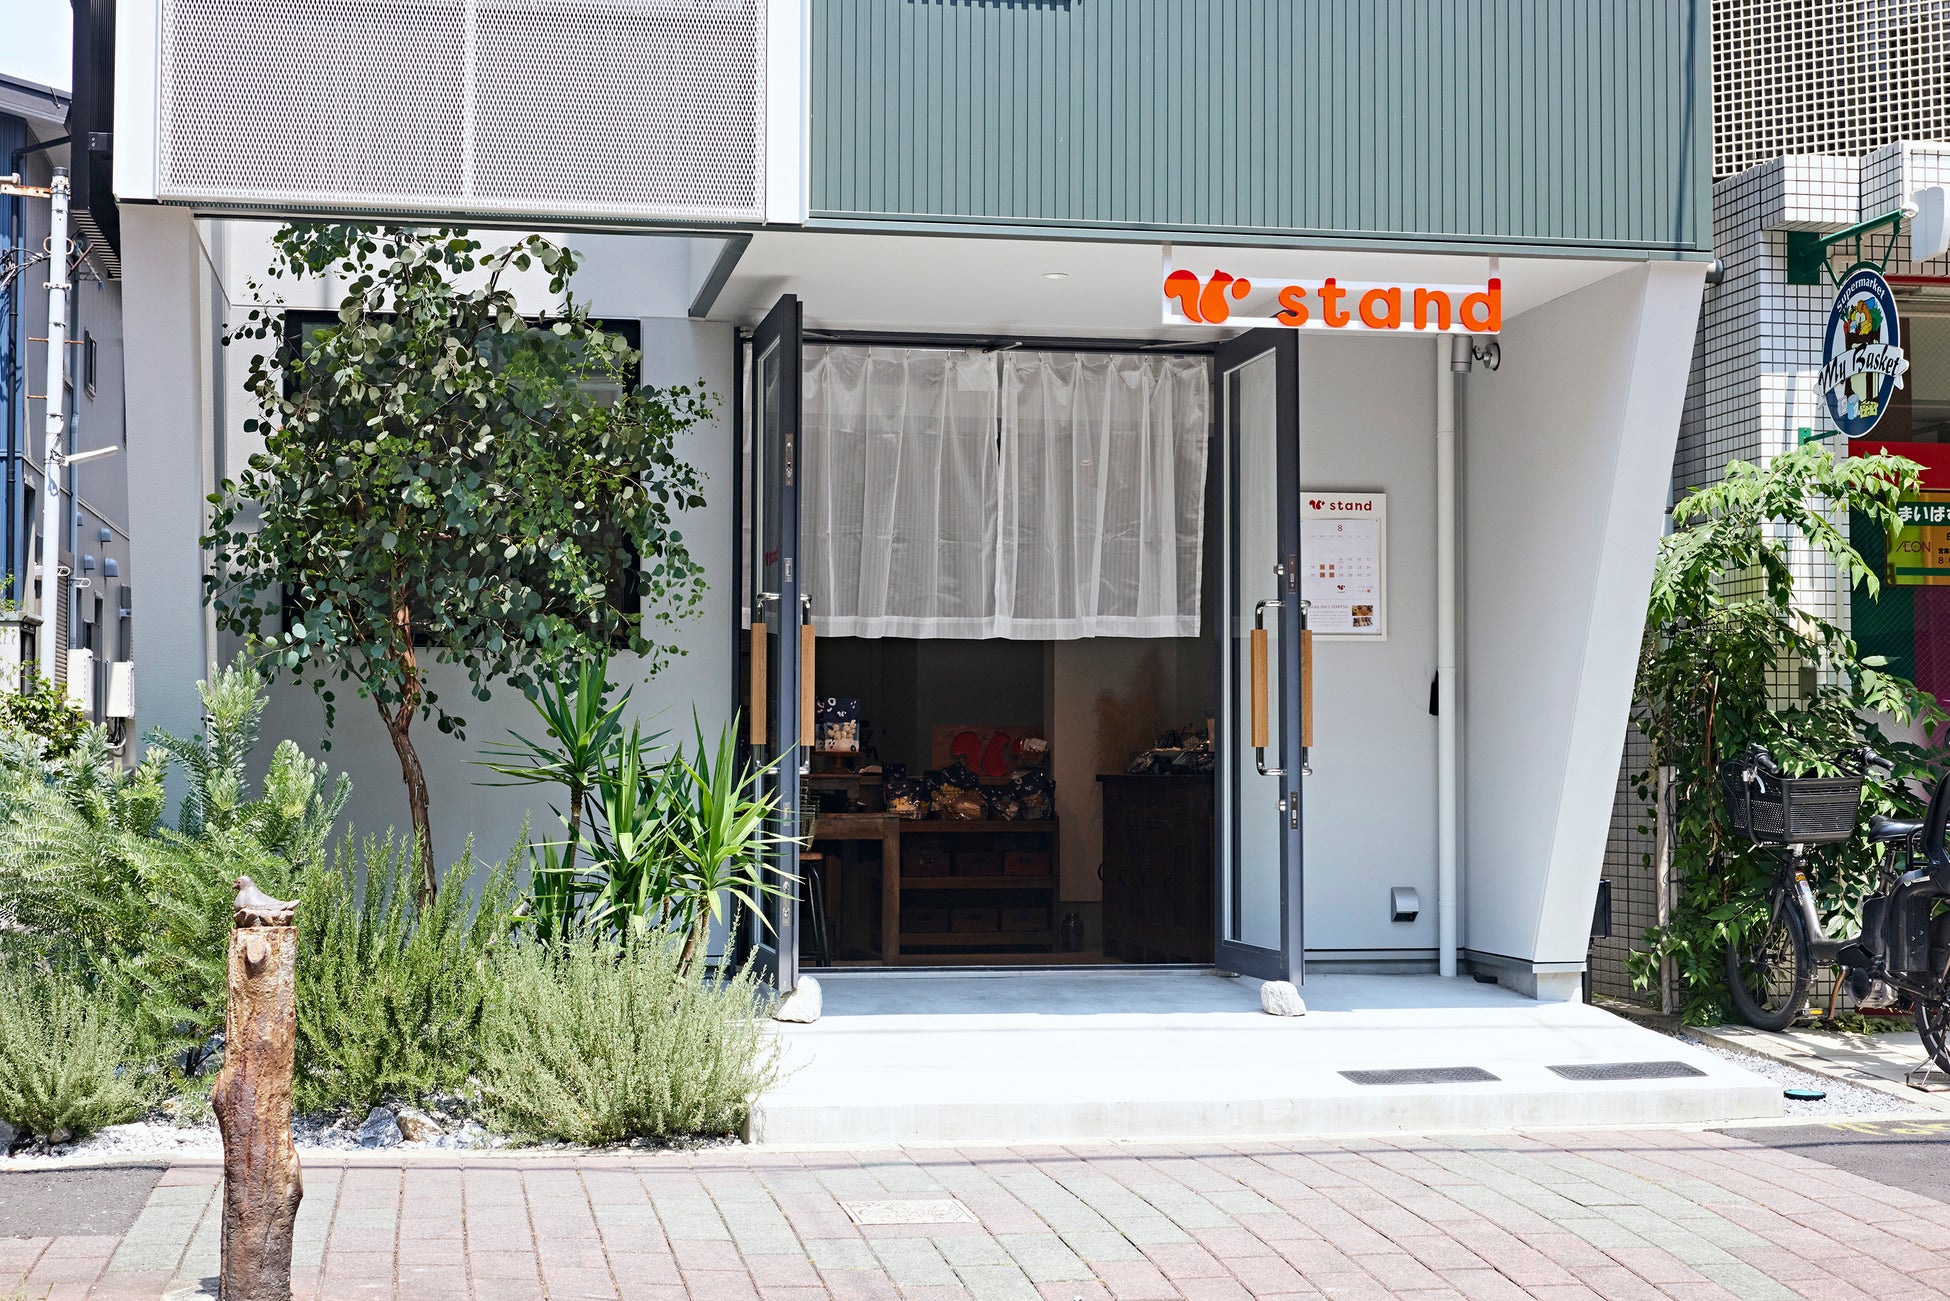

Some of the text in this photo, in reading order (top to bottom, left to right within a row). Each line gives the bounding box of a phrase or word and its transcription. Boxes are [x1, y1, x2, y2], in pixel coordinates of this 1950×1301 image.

[1277, 277, 1502, 332] stand
[1819, 342, 1900, 395] My Basket
[1329, 500, 1373, 511] stand
[1898, 505, 1950, 522] まいば
[1337, 524, 1343, 532] 8
